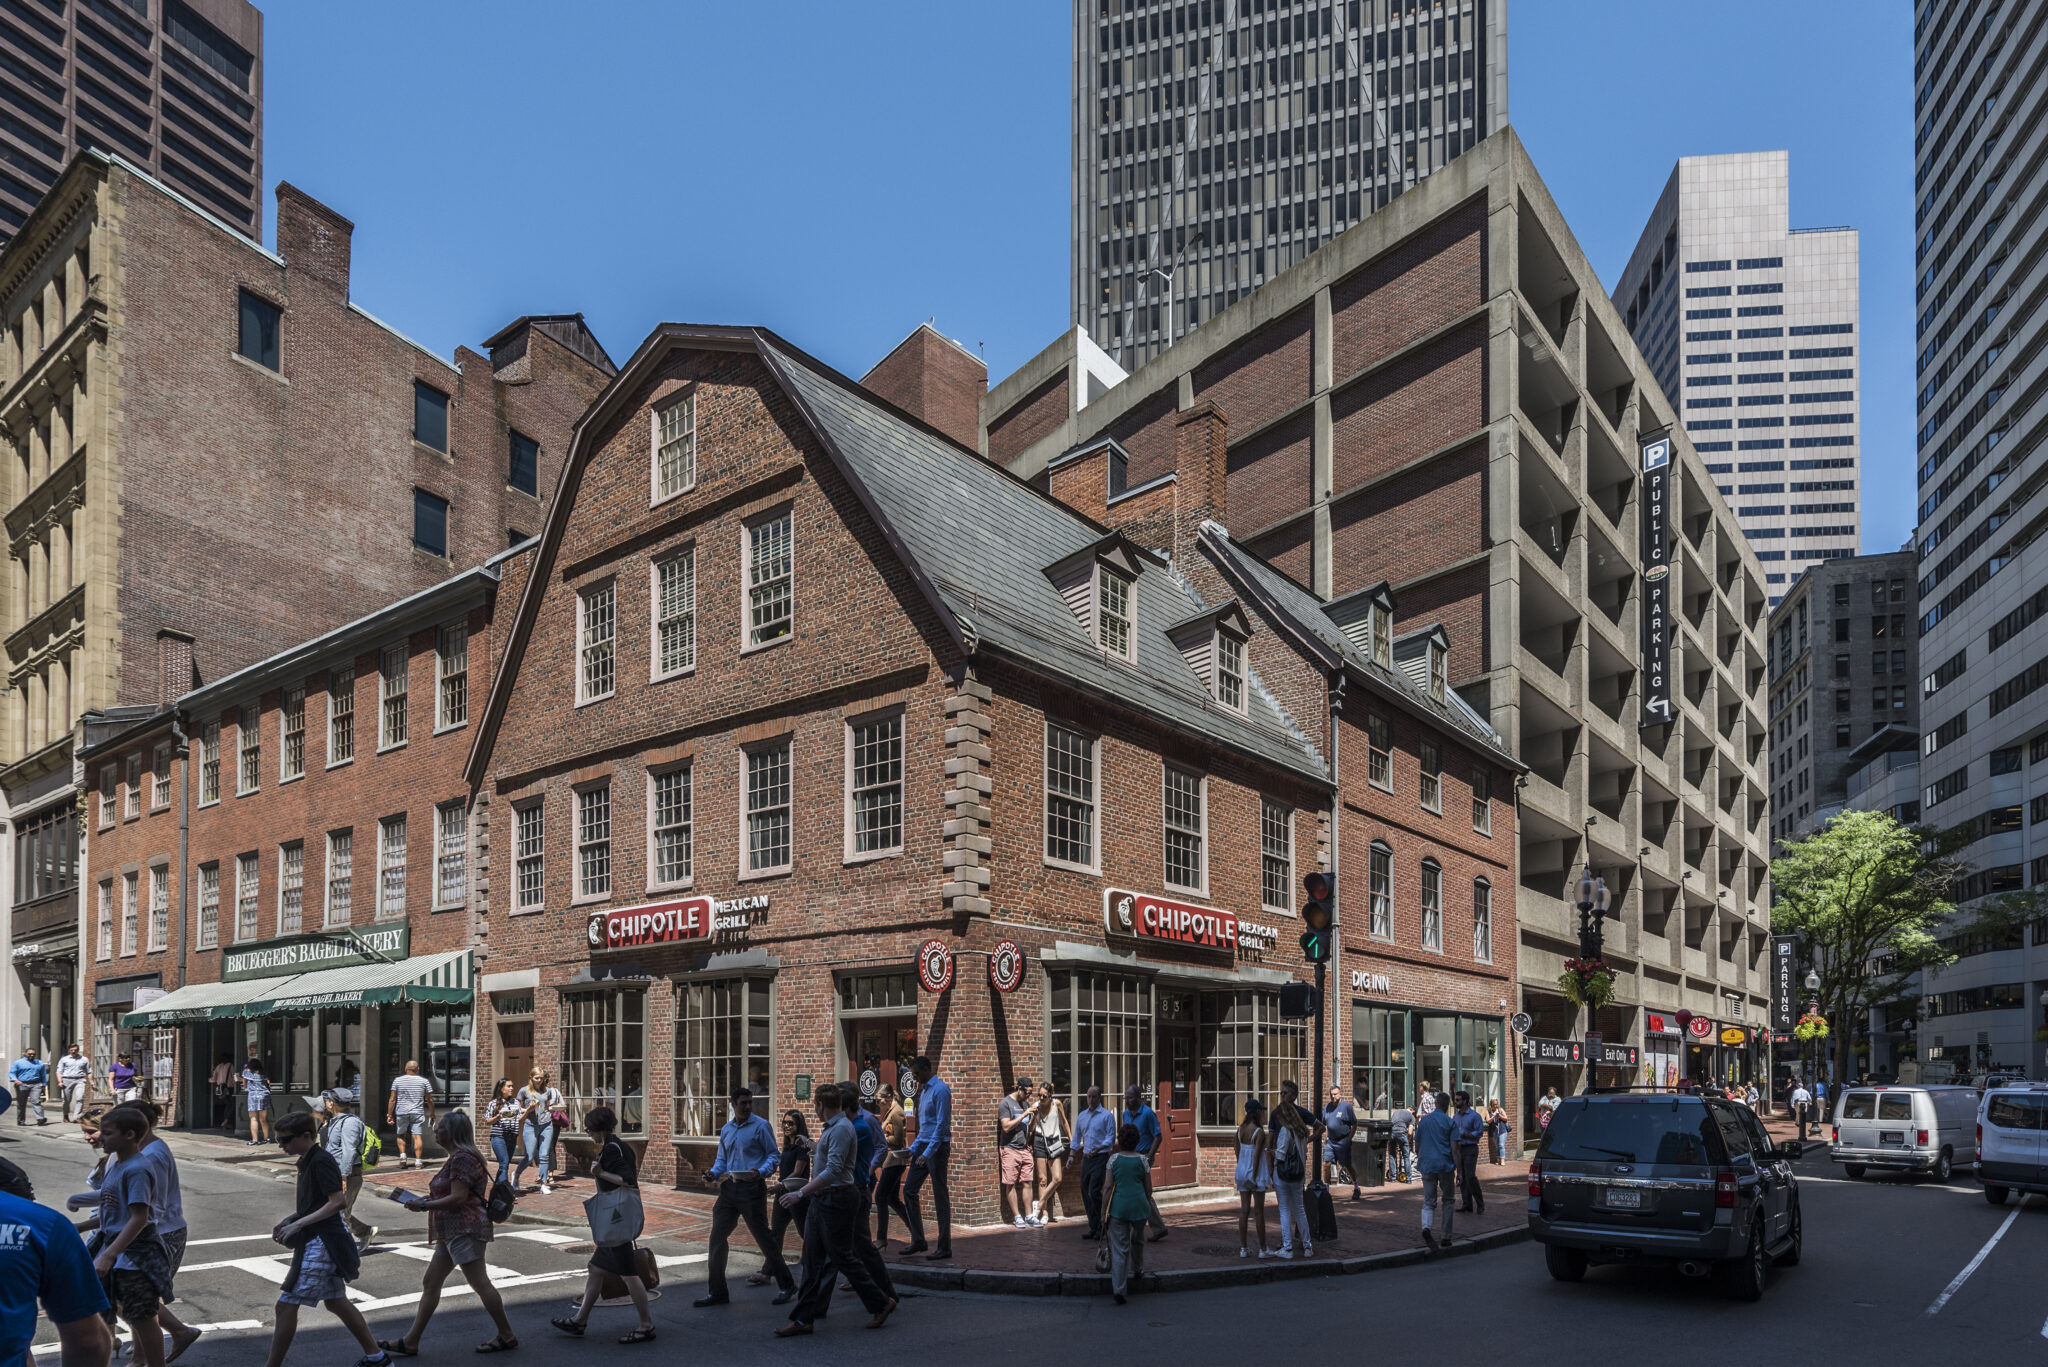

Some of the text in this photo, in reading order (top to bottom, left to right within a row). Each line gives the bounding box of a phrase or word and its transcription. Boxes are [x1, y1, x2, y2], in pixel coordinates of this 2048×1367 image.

[1648, 445, 1665, 468] P
[1651, 476, 1662, 559] PUBLIC
[1651, 588, 1662, 687] PARKING
[714, 895, 769, 914] MEXICAN
[608, 907, 700, 939] CHIPOTLE
[714, 914, 749, 930] GRILL
[1144, 905, 1236, 940] CHIPOTLE
[1238, 920, 1278, 938] MEXICAN
[227, 929, 403, 973] BRUEGGER'S BAGEL BAKERY
[921, 941, 951, 963] CHIPOTLE
[992, 941, 1020, 963] CHIPOTLE
[1238, 936, 1265, 950] GRILL
[1780, 945, 1789, 954] P
[1352, 970, 1389, 991] DIG INN
[1781, 957, 1789, 1012] PARKING
[312, 993, 334, 1005] BAGEL
[334, 990, 364, 1002] BAKERY
[1541, 1043, 1554, 1057] Exit
[1555, 1044, 1568, 1061] Only
[1605, 1048, 1627, 1064] Exit Only
